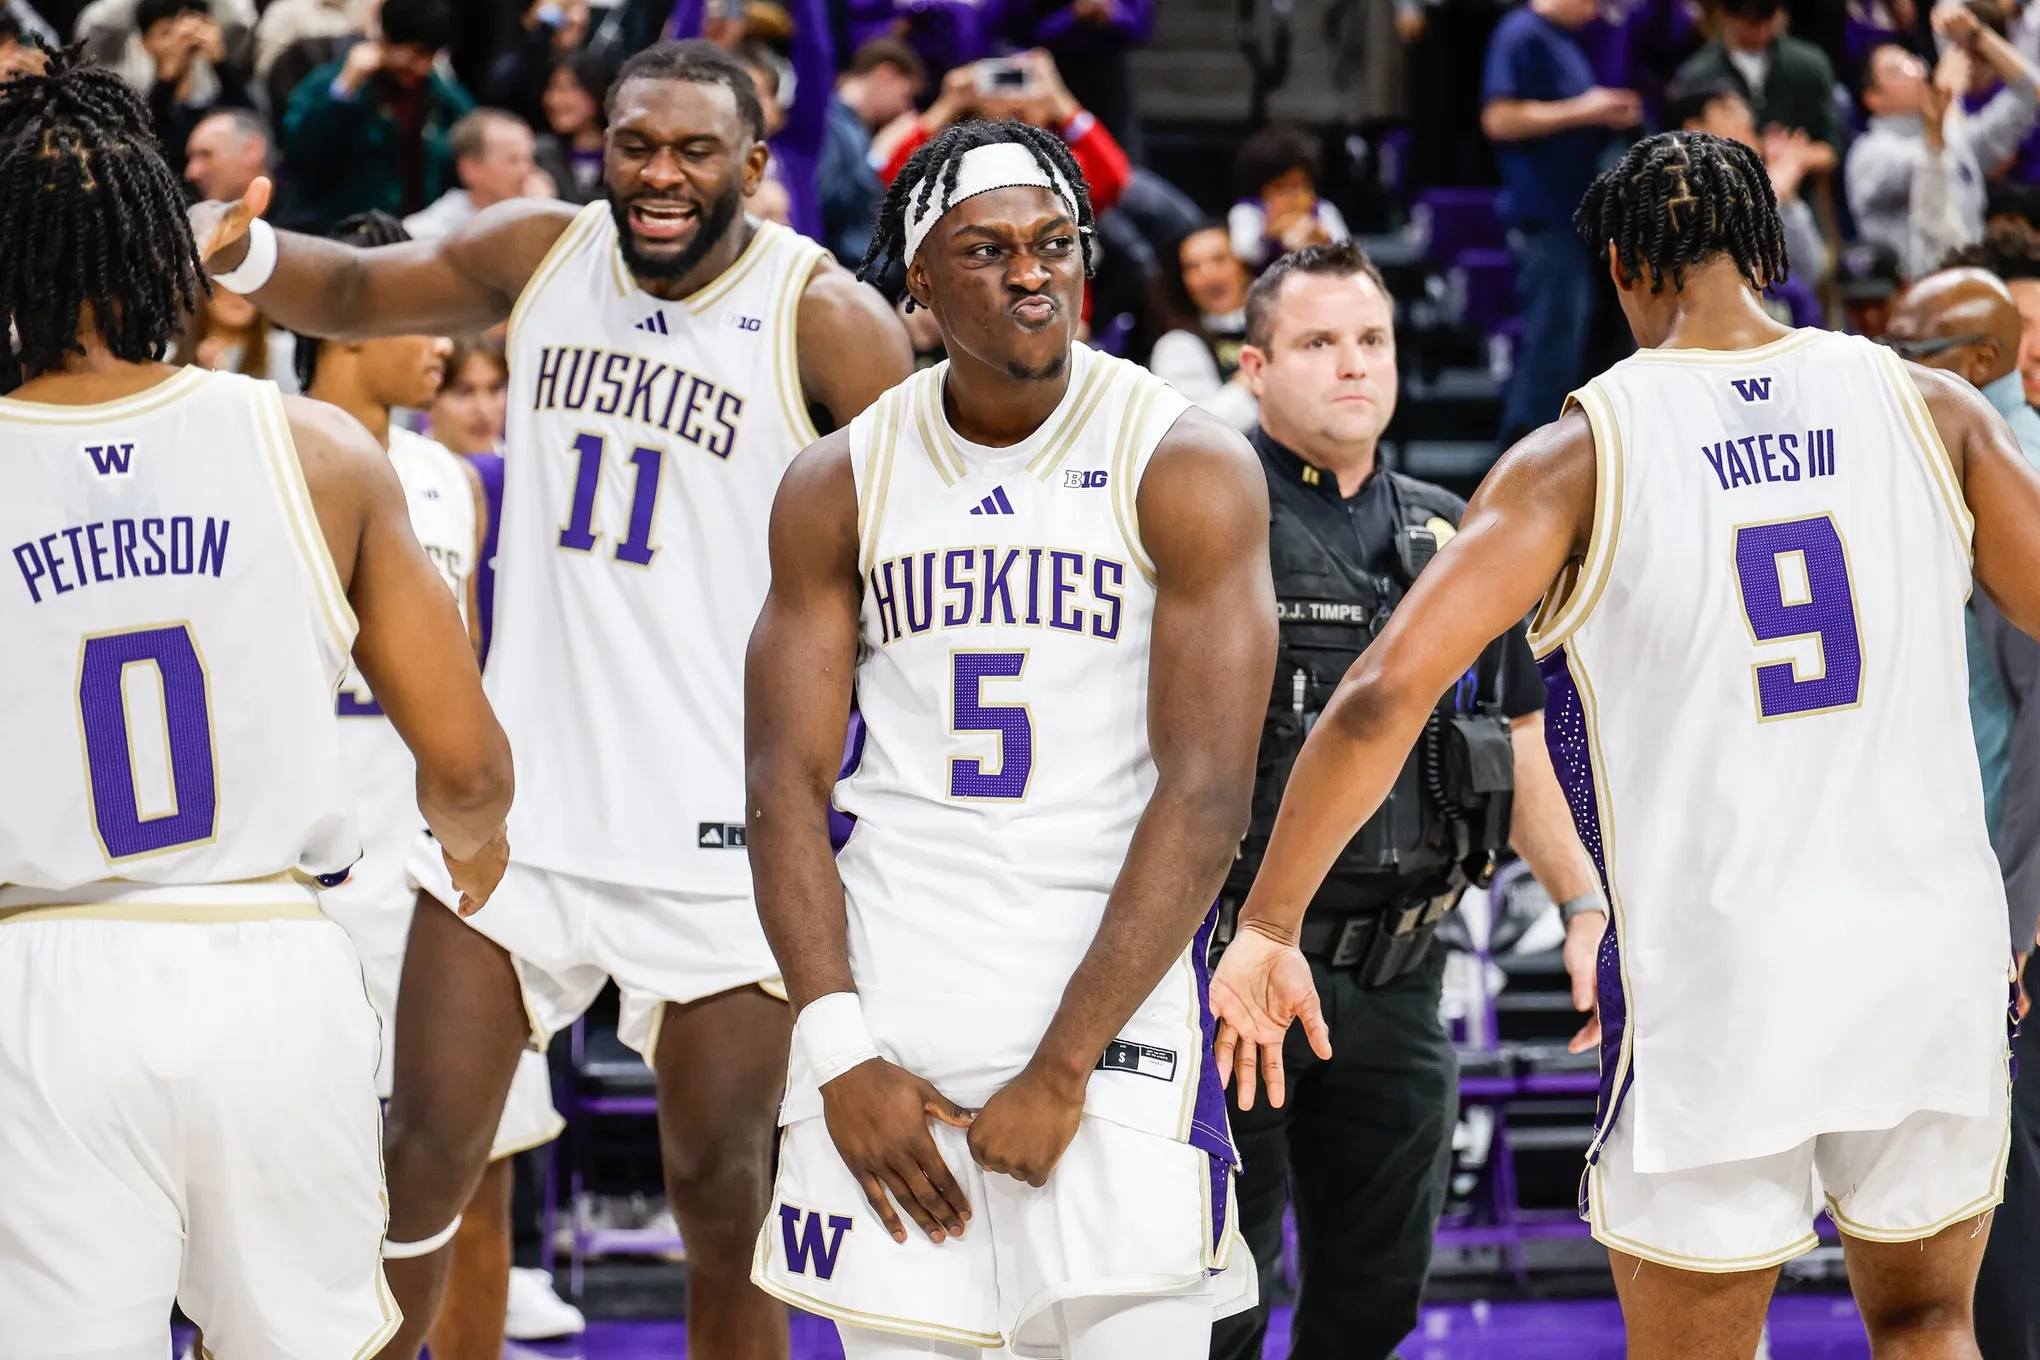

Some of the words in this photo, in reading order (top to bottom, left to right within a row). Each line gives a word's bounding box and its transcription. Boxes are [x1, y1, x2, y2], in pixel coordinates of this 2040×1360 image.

[533, 346, 746, 463] HUSKIES
[1731, 376, 1772, 402] W
[85, 443, 134, 475] W
[556, 429, 664, 568] 11
[1701, 433, 1801, 491] YATES
[1807, 428, 1836, 479] III
[12, 515, 231, 605] PETERSON
[868, 546, 1127, 647] HUSKIES
[1308, 602, 1363, 622] TIMPE
[1731, 511, 1866, 723] 9
[74, 619, 220, 866] 0
[945, 648, 1037, 802] 5
[1118, 1051, 1126, 1063] S
[778, 1202, 854, 1281] W
